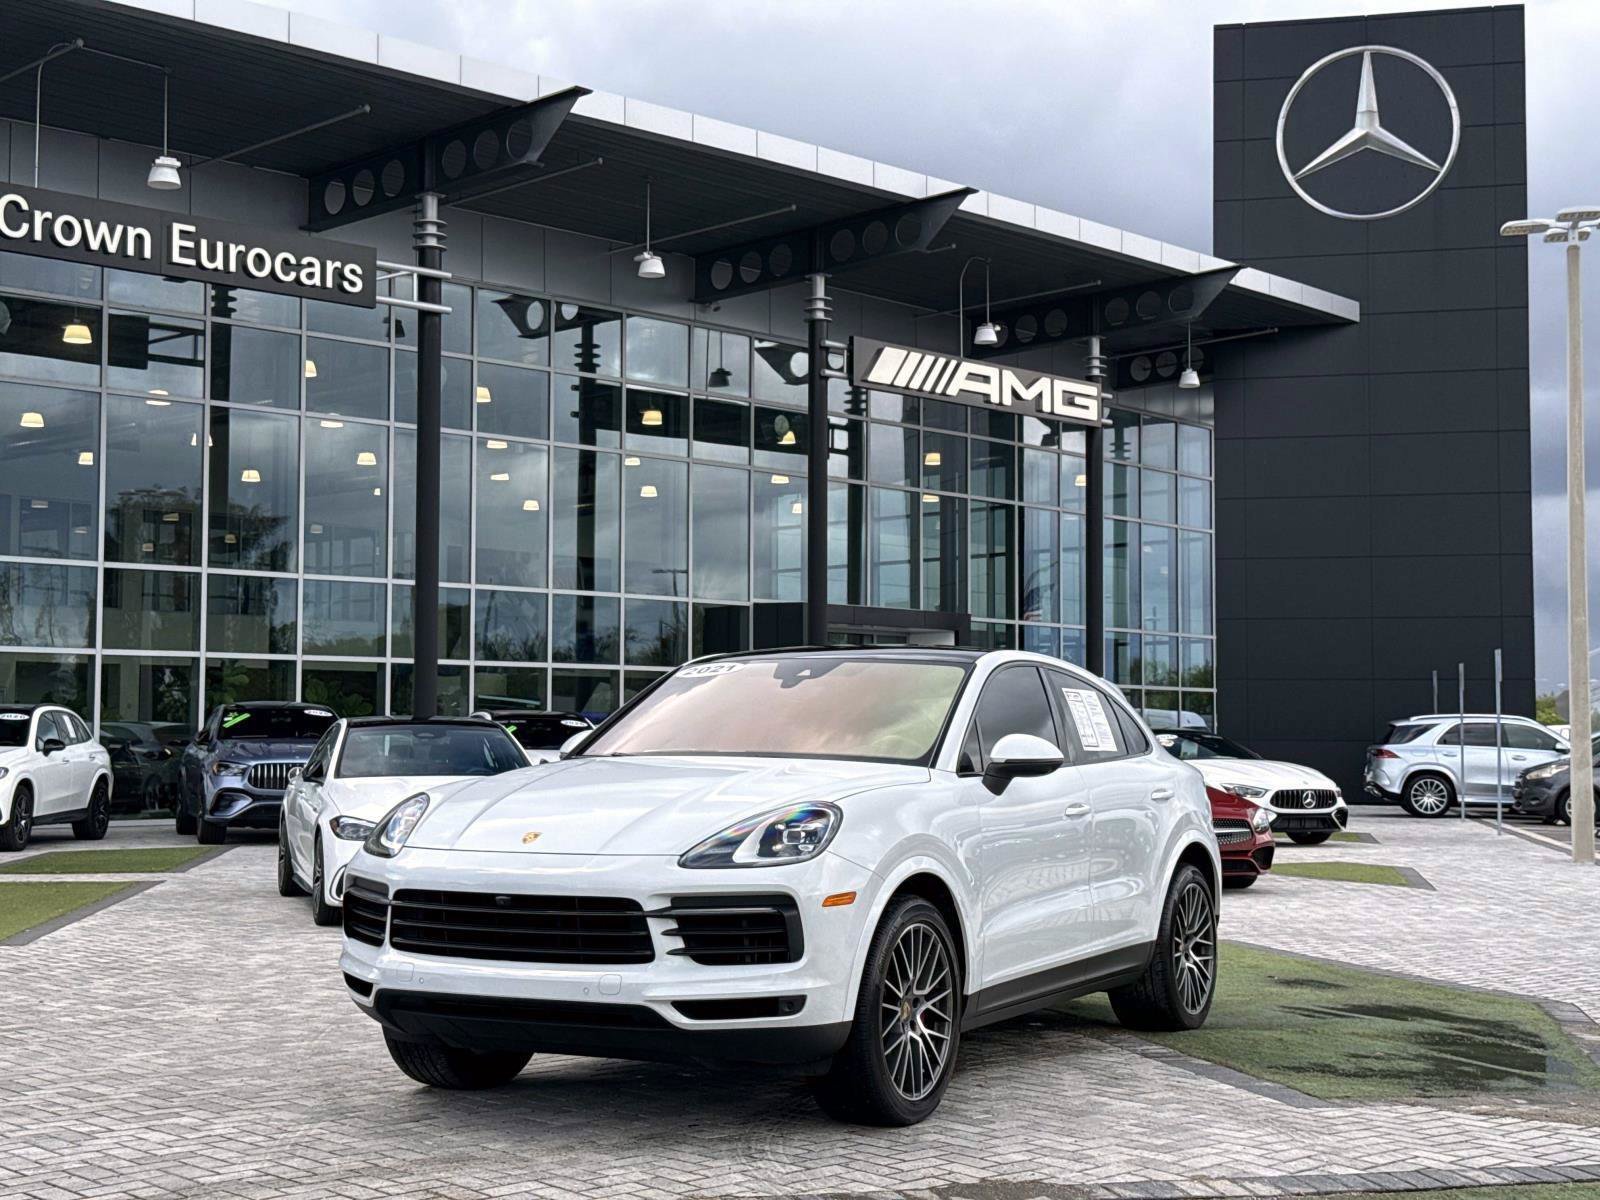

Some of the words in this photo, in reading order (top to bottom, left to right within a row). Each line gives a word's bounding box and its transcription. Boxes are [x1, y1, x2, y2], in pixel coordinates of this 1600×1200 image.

[0, 193, 152, 260] Crown
[168, 222, 364, 294] Eurocars
[946, 360, 1098, 421] AMG
[682, 664, 737, 676] 2021
